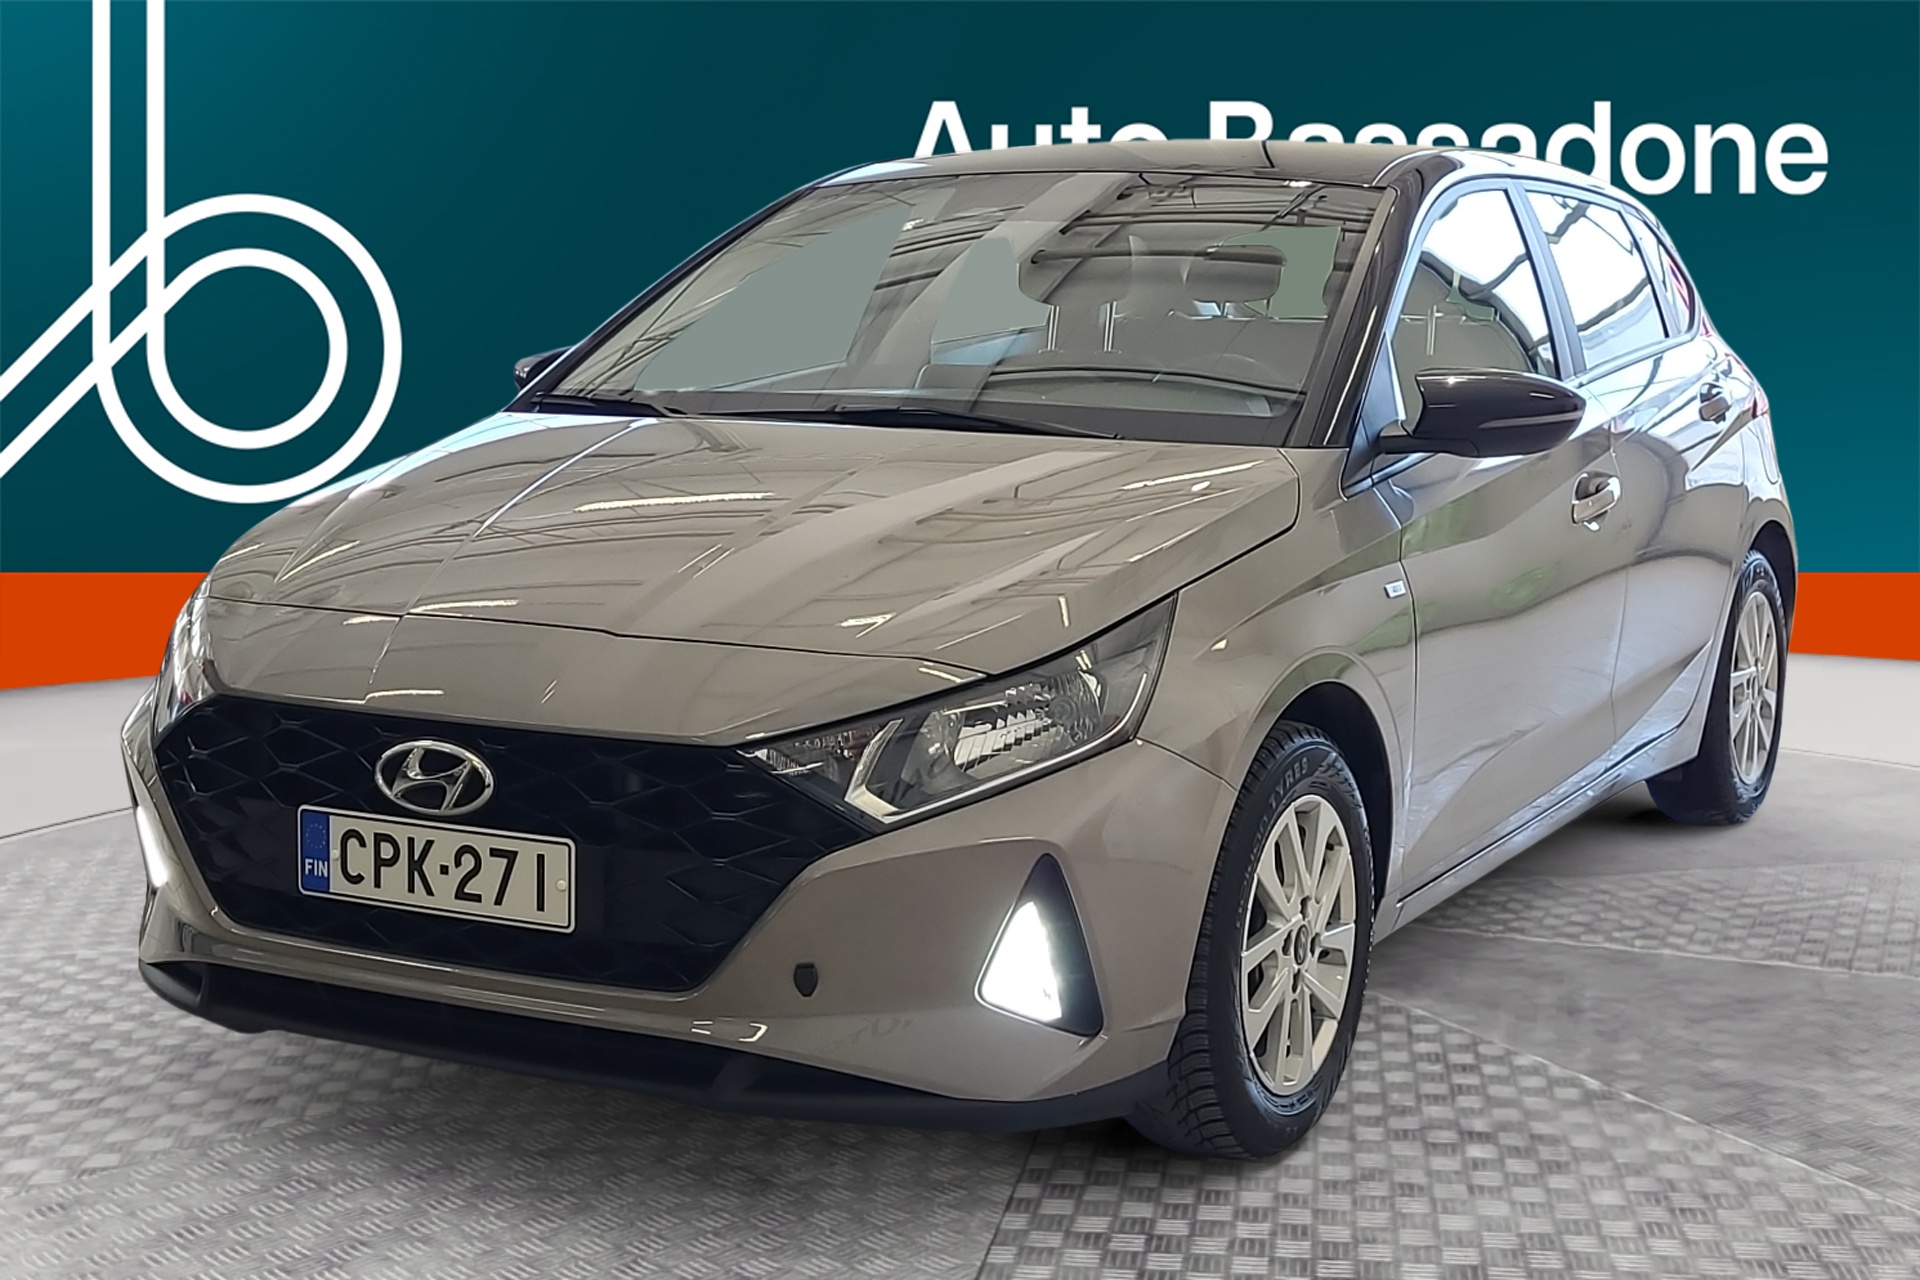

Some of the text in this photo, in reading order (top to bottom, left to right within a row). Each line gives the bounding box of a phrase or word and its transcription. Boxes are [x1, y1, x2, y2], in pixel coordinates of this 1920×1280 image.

[913, 101, 1829, 196] At adone
[1268, 756, 1309, 810] TYRES
[305, 858, 328, 878] FIN
[340, 828, 546, 912] CPK-271
